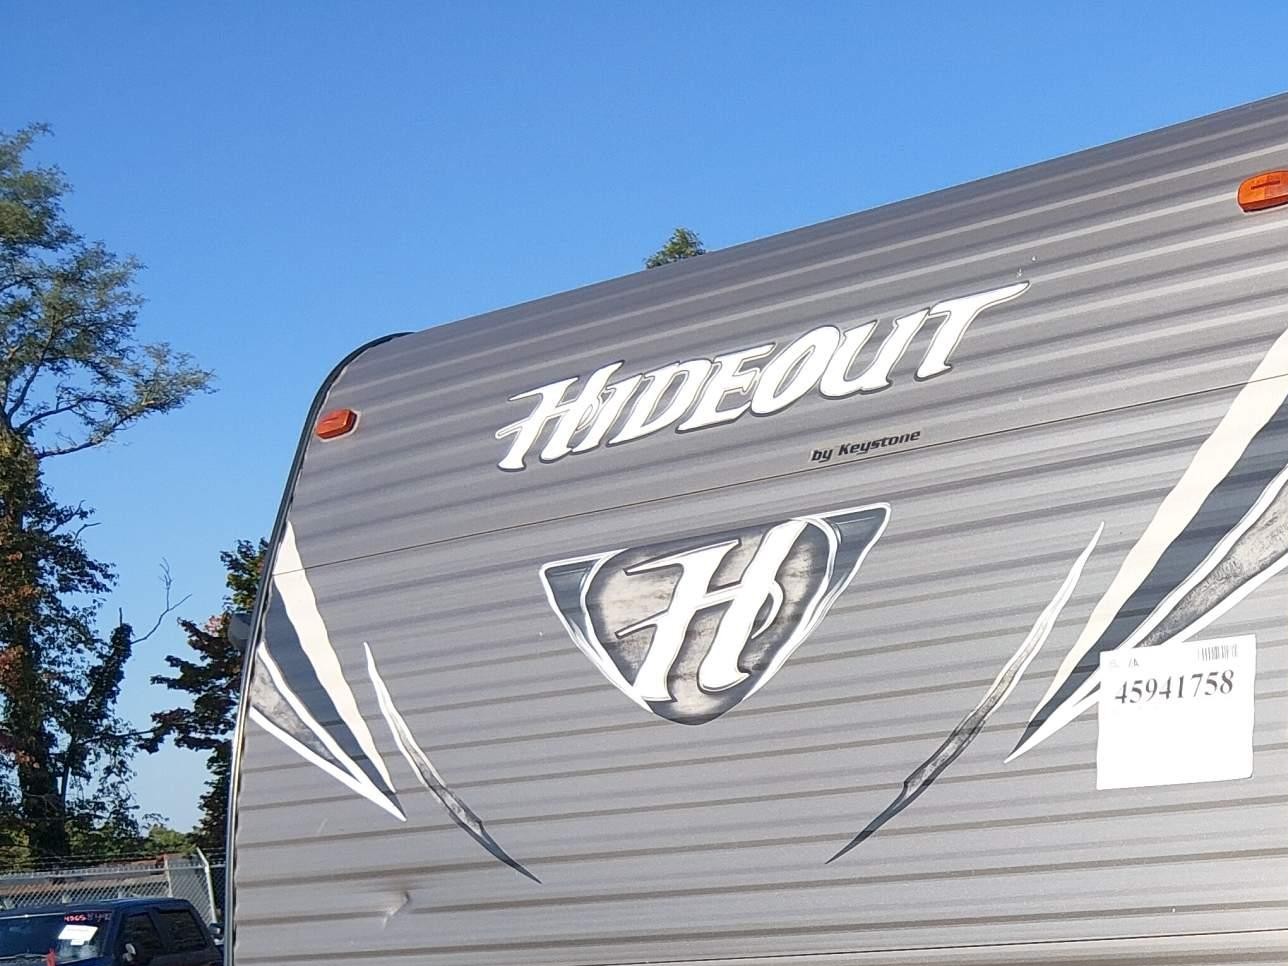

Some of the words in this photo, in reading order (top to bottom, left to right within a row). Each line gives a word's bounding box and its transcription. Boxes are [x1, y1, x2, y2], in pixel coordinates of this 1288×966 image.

[495, 281, 1030, 471] HIDEOUT
[811, 448, 833, 463] by
[838, 431, 921, 456] Keystone
[1114, 669, 1235, 704] 45941758
